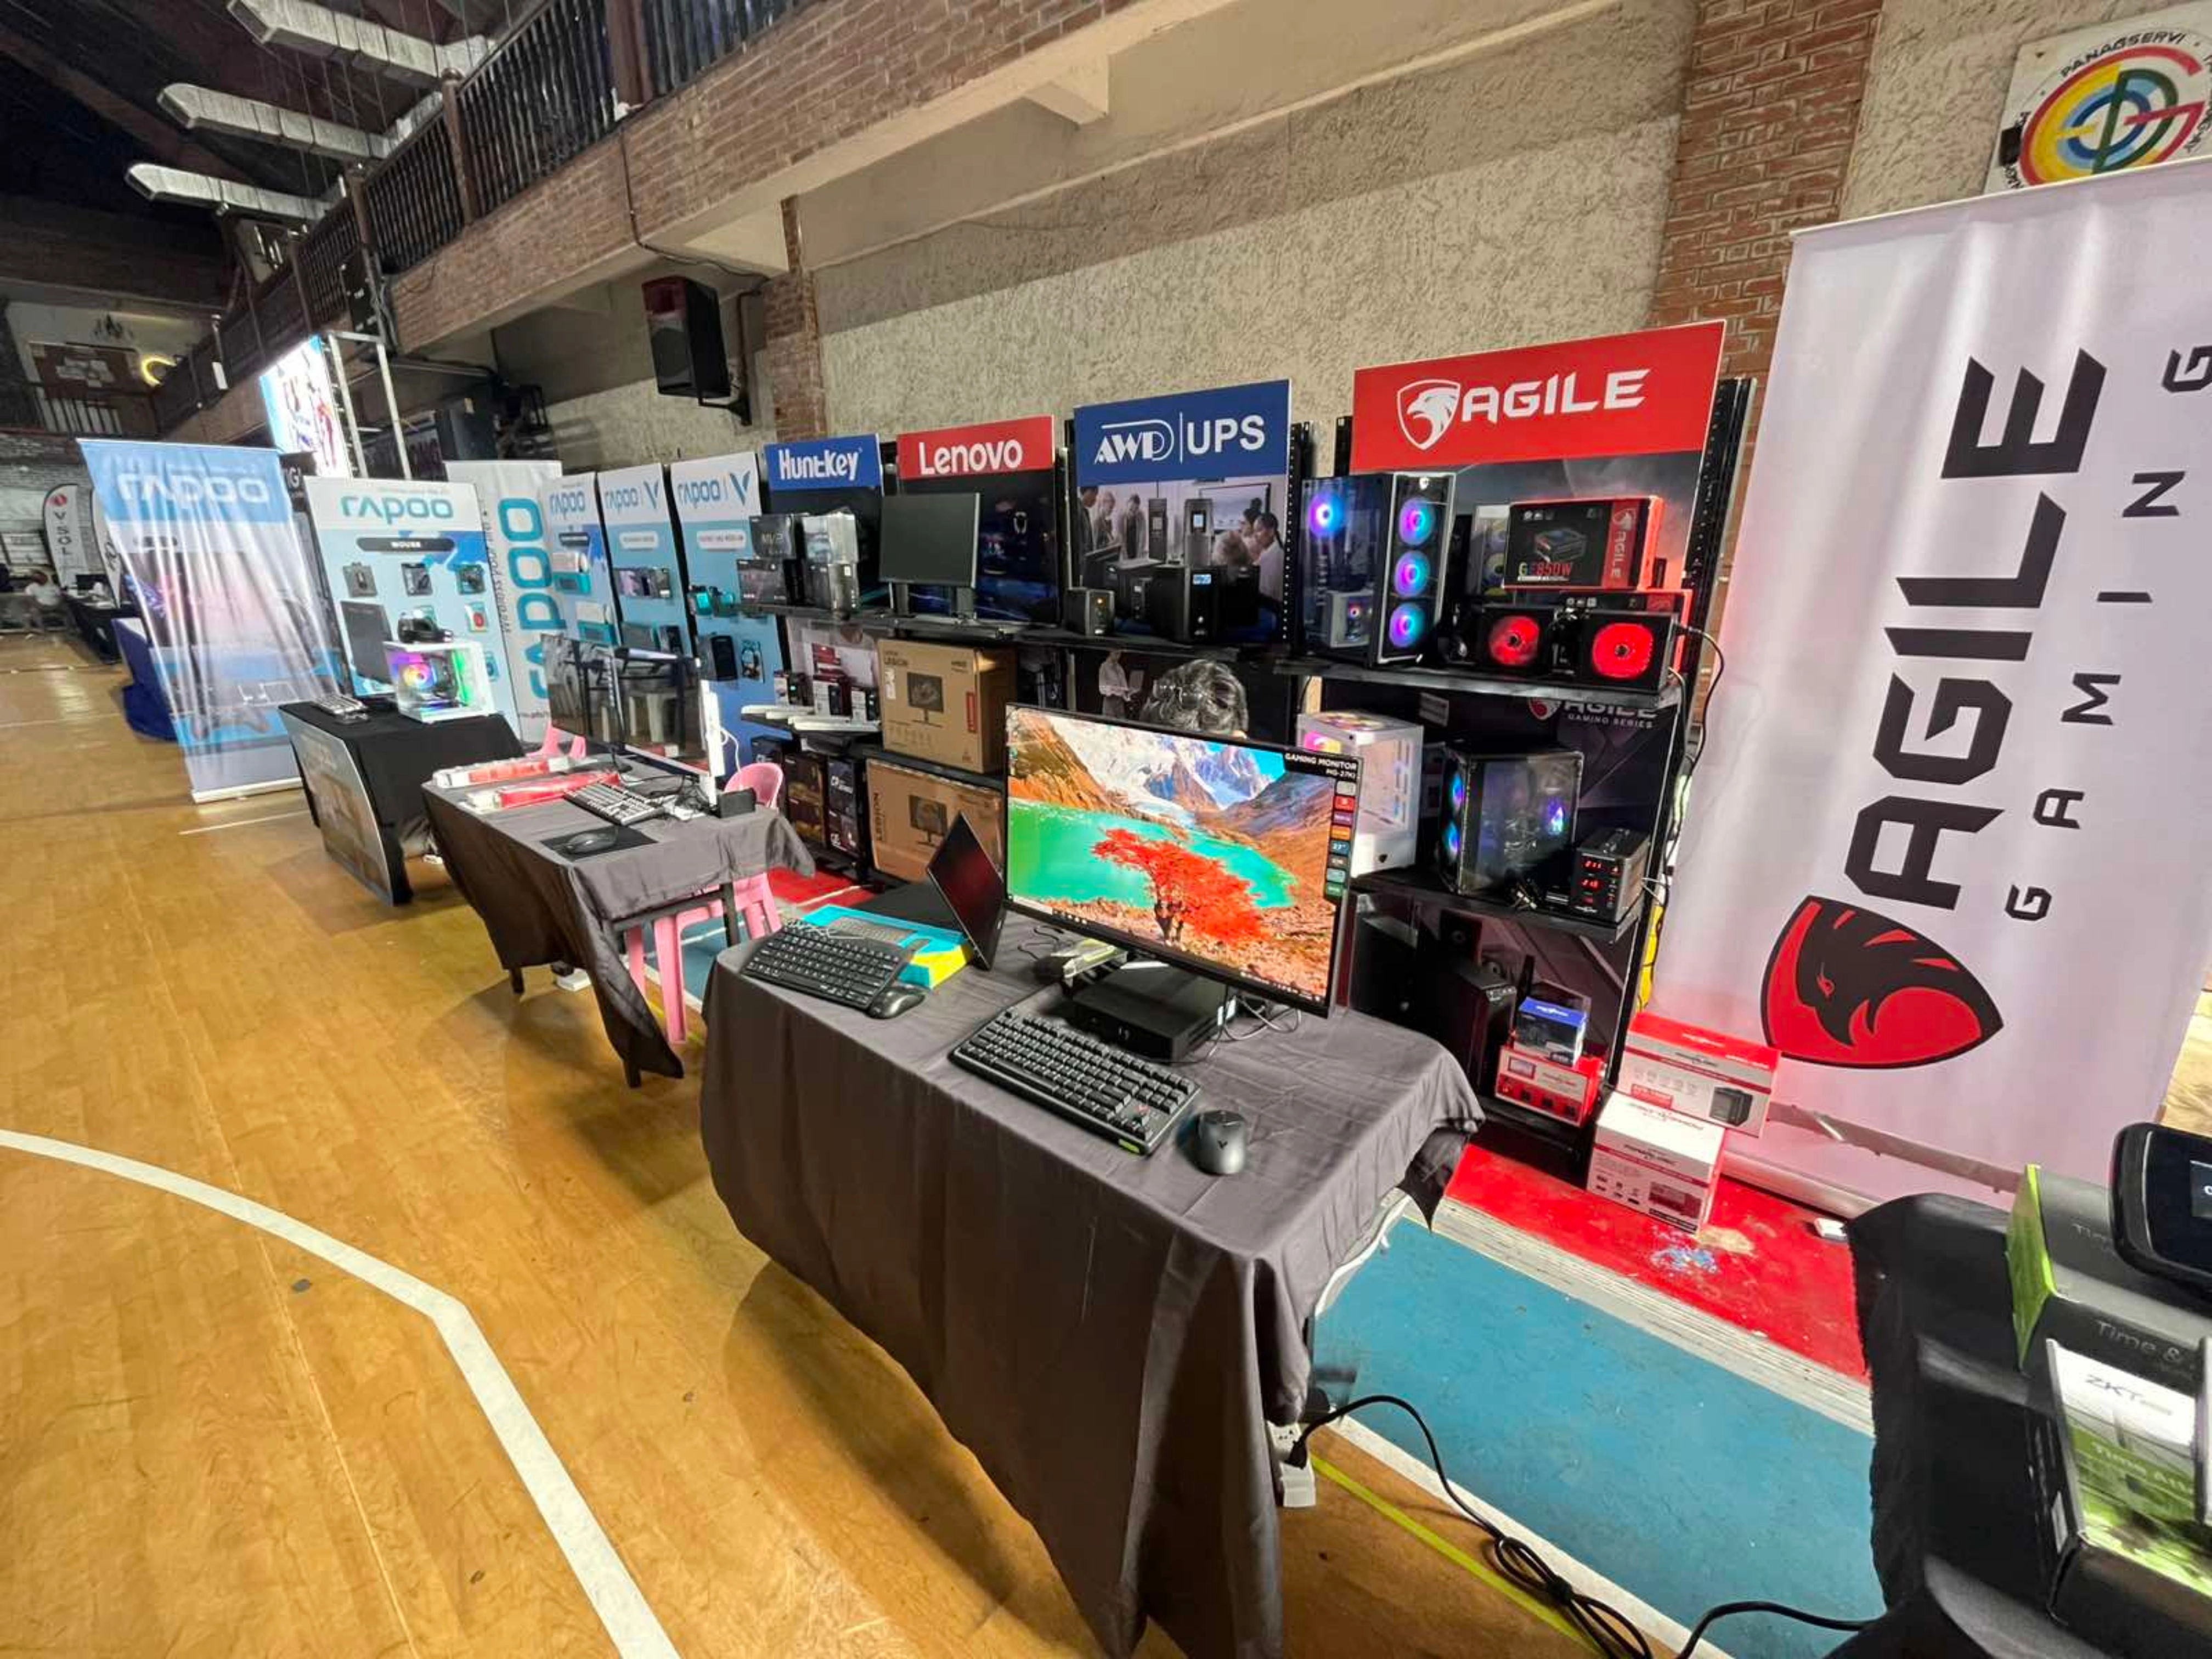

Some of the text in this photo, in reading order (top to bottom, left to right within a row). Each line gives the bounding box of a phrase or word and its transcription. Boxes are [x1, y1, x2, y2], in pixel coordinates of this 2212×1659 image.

[1462, 369, 1650, 424] AGILE
[919, 438, 1023, 476] Lenovo
[1094, 415, 1265, 464] AWD UPS
[1844, 347, 2107, 911] AGILE
[2004, 345, 2212, 921] GAMING
[1285, 753, 1358, 770] GAMING MONITOR
[2095, 1319, 2156, 1350] Time
